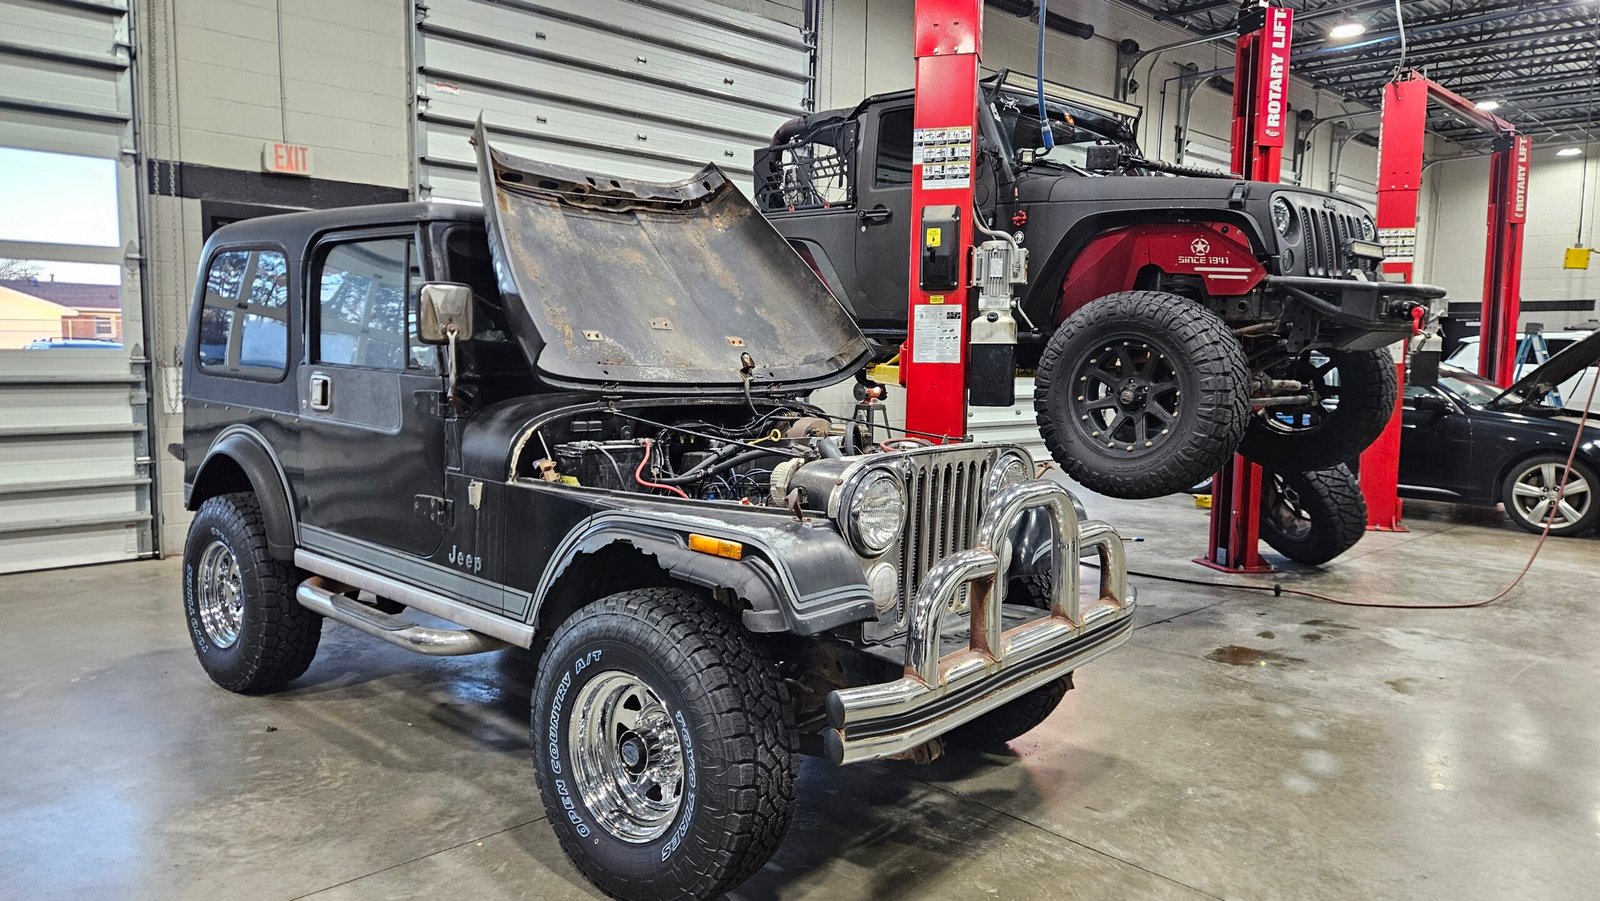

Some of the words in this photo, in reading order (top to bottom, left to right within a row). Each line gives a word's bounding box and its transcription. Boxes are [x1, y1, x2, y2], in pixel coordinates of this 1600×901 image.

[1272, 8, 1287, 48] LIFT
[1267, 53, 1284, 127] ROTARY
[274, 143, 308, 172] EXIT
[1518, 137, 1528, 162] LIFT
[1515, 165, 1526, 212] ROTARY
[1208, 256, 1230, 265] 1941
[448, 544, 482, 574] Jeep
[190, 617, 209, 653] TOYO
[575, 650, 602, 675] A/T
[549, 671, 572, 775] COUNTRY
[675, 710, 697, 789] TOYO
[556, 779, 590, 838] OPEN
[661, 792, 696, 862] TIRES
